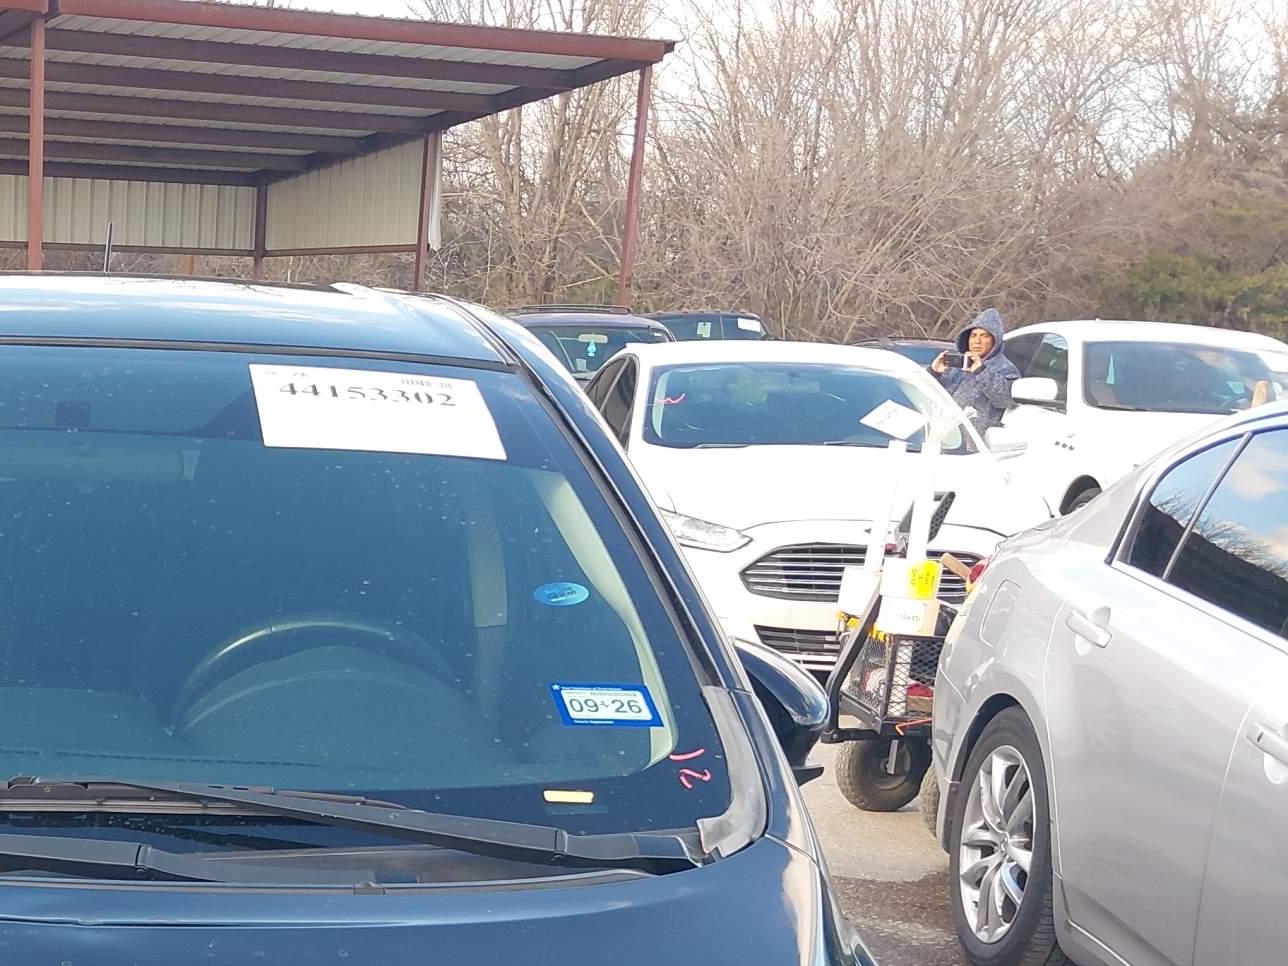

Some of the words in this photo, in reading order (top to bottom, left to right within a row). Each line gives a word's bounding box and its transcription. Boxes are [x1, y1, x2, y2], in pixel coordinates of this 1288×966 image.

[280, 382, 456, 407] 44153302
[569, 698, 600, 714] 09
[610, 699, 642, 714] 26
